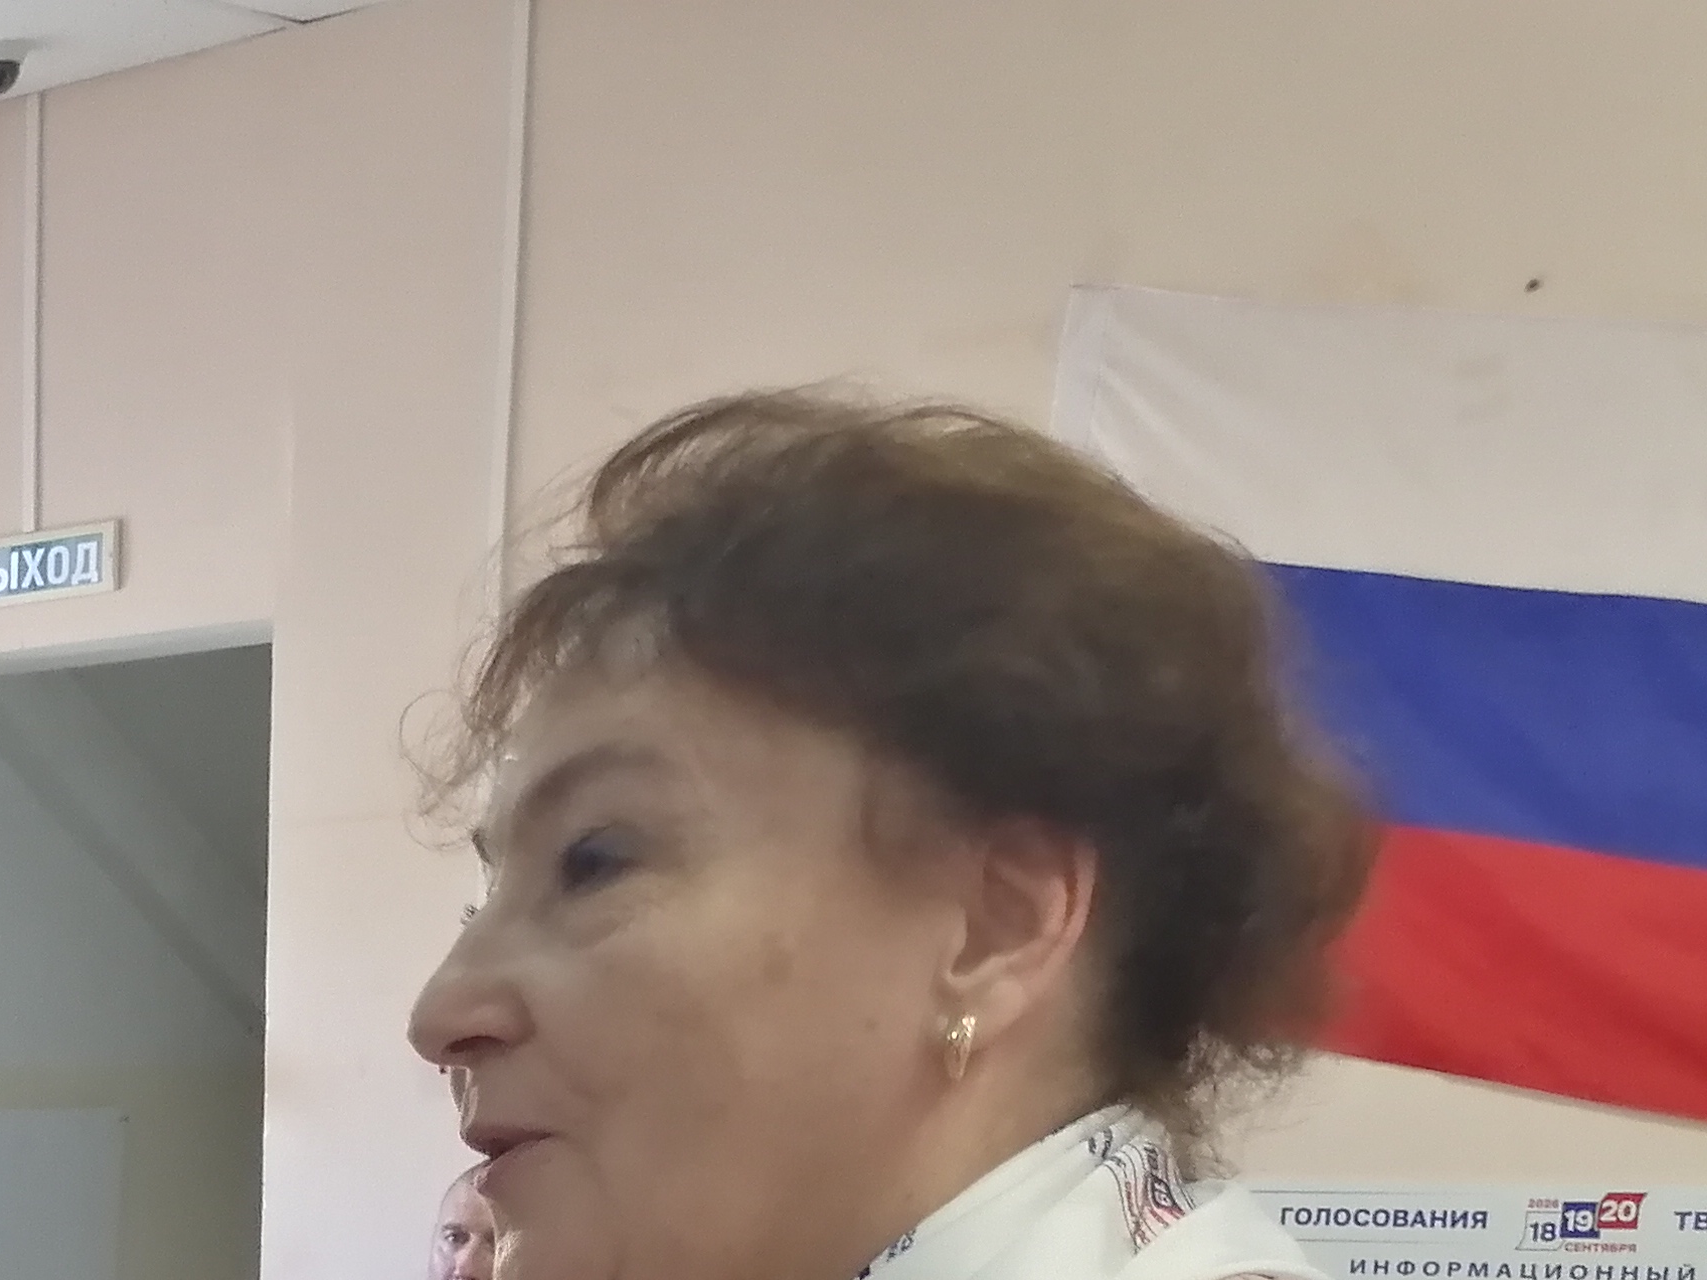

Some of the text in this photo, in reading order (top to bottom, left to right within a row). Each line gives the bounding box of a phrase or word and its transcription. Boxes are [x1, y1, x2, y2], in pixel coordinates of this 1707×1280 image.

[1280, 1206, 1489, 1230] ГОЛОСОВАНИЯ
[1530, 1200, 1637, 1242] 18 19 20
[1564, 1243, 1637, 1254] СЕНТЯБРЯ
